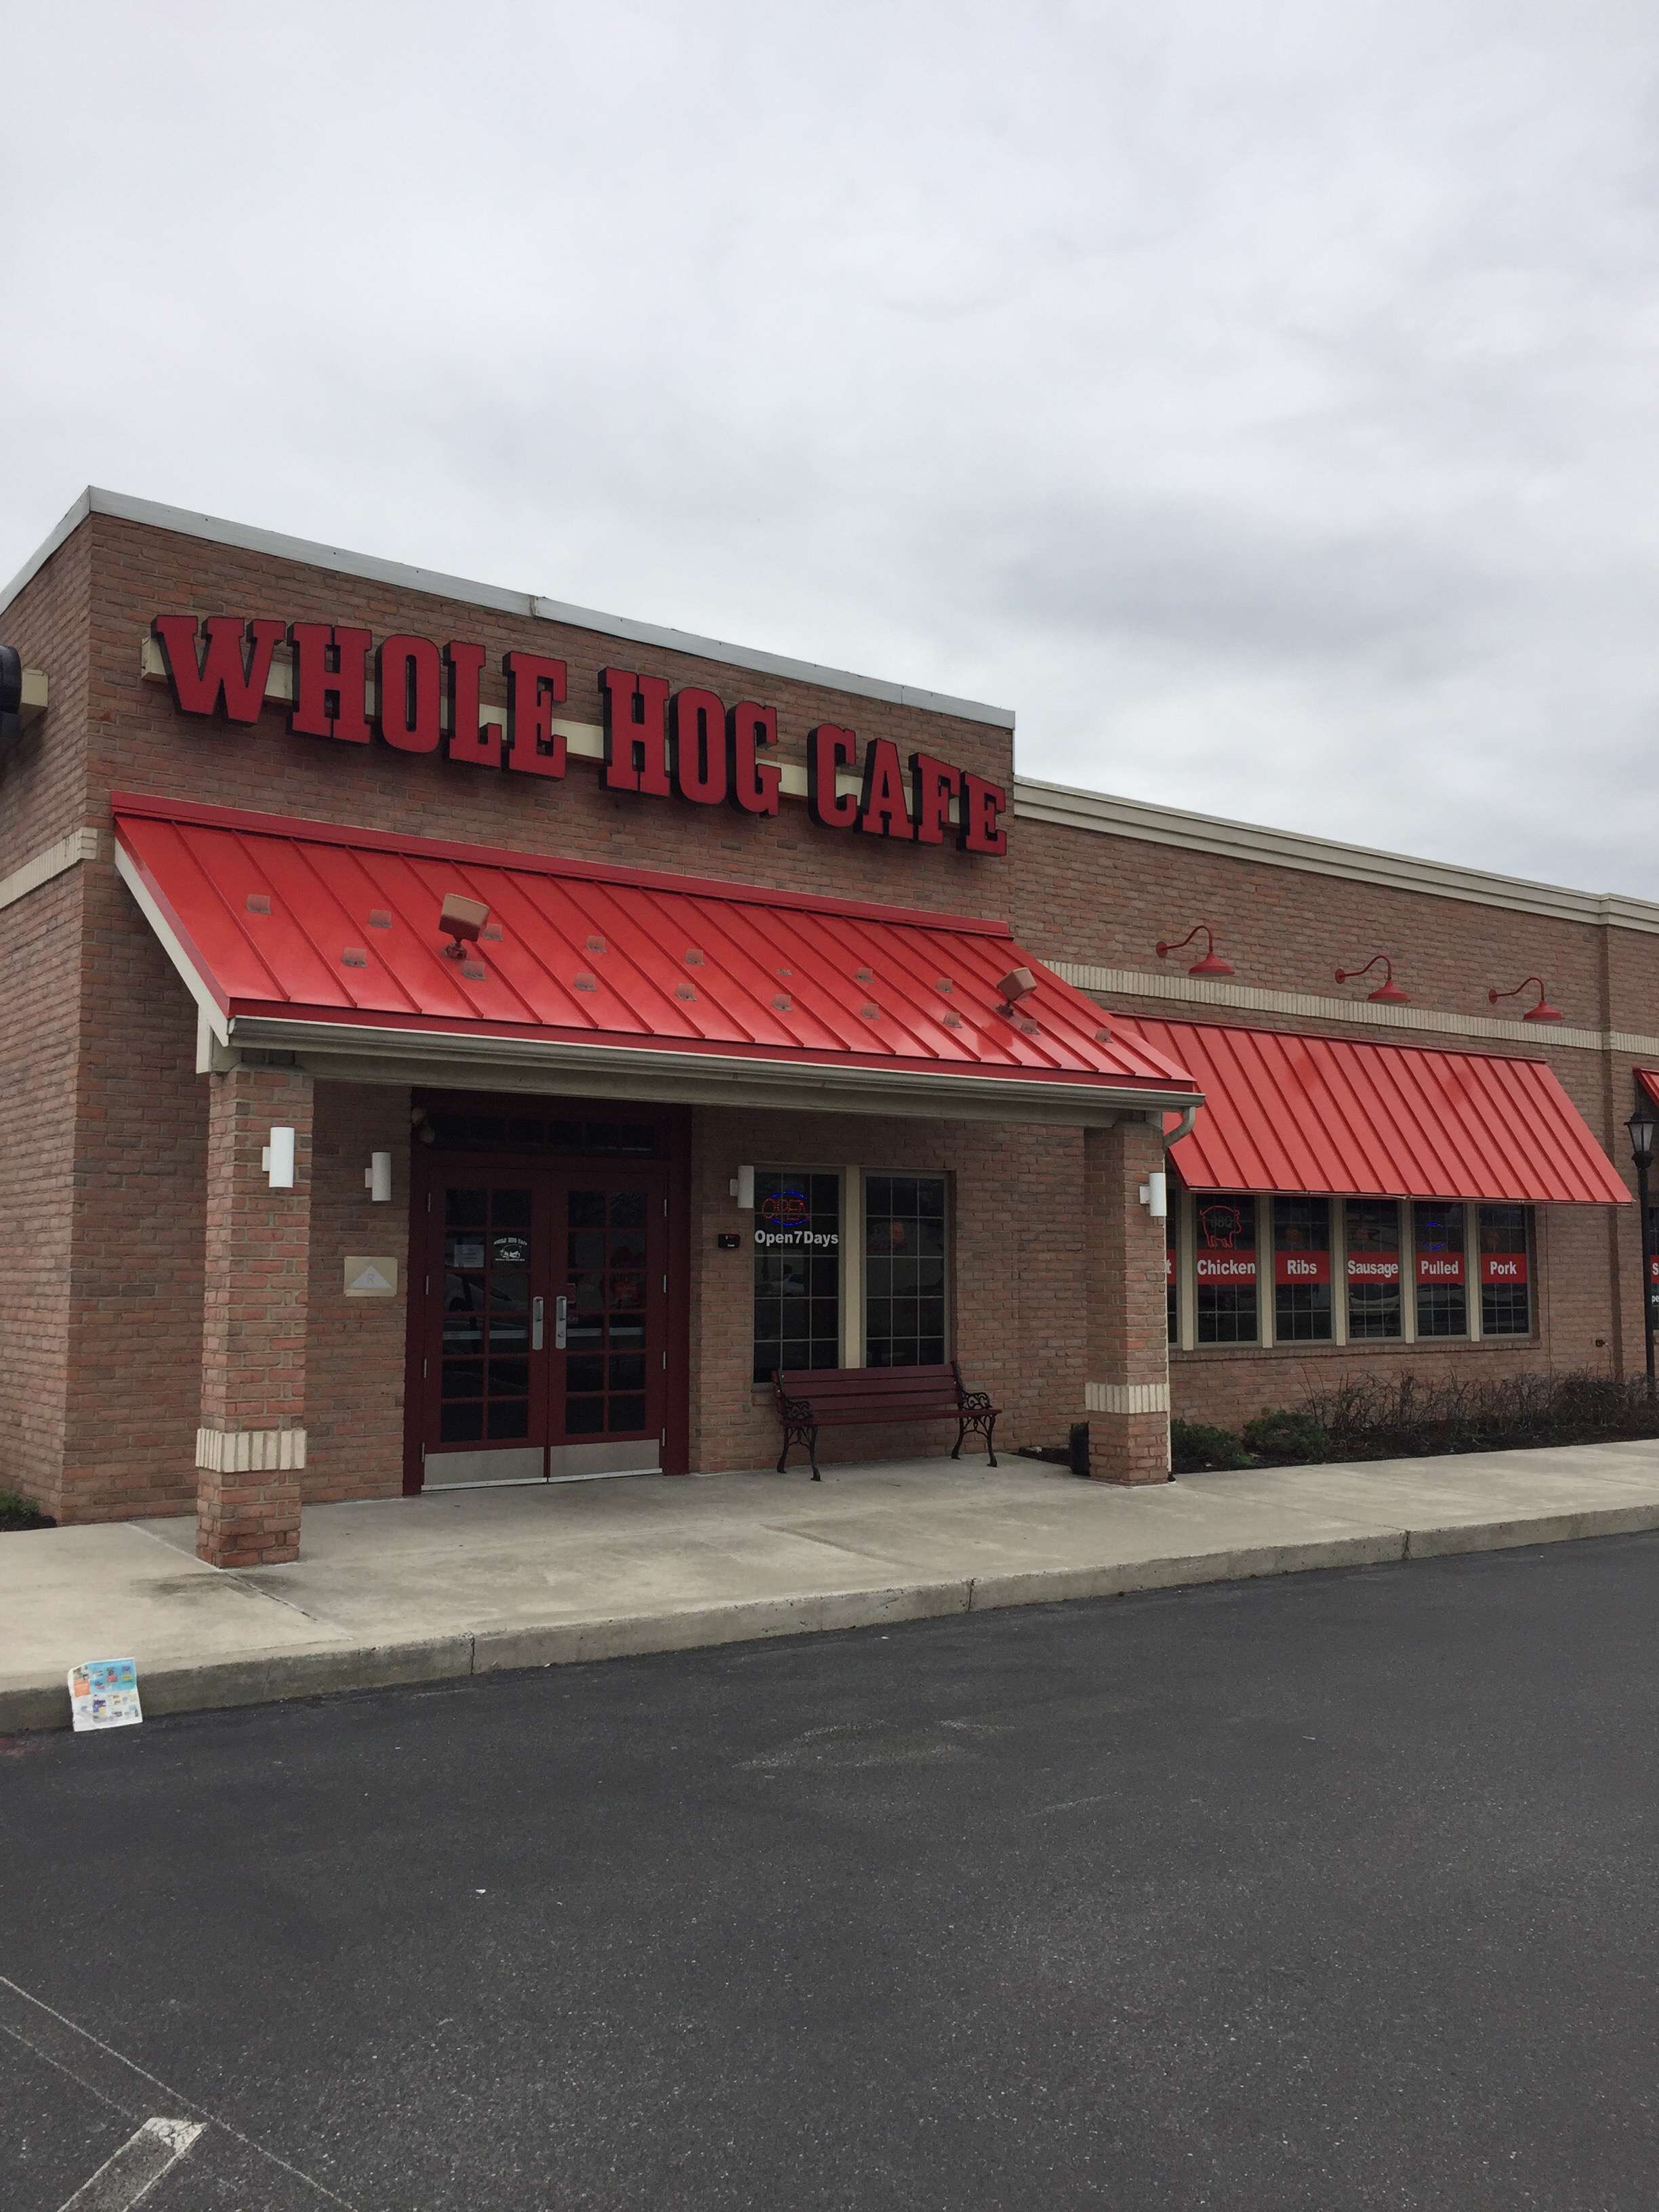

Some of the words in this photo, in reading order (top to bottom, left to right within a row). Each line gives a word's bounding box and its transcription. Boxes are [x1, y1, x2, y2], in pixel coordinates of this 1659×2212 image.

[151, 615, 567, 781] WHOLE
[598, 665, 781, 817] HOG
[807, 722, 1007, 857] CAFE
[1197, 1259, 1256, 1275] Chicken
[1287, 1259, 1317, 1275] Ribs
[1347, 1260, 1399, 1278] Sausage
[1420, 1261, 1459, 1275] Pulled
[1490, 1261, 1517, 1275] Pork
